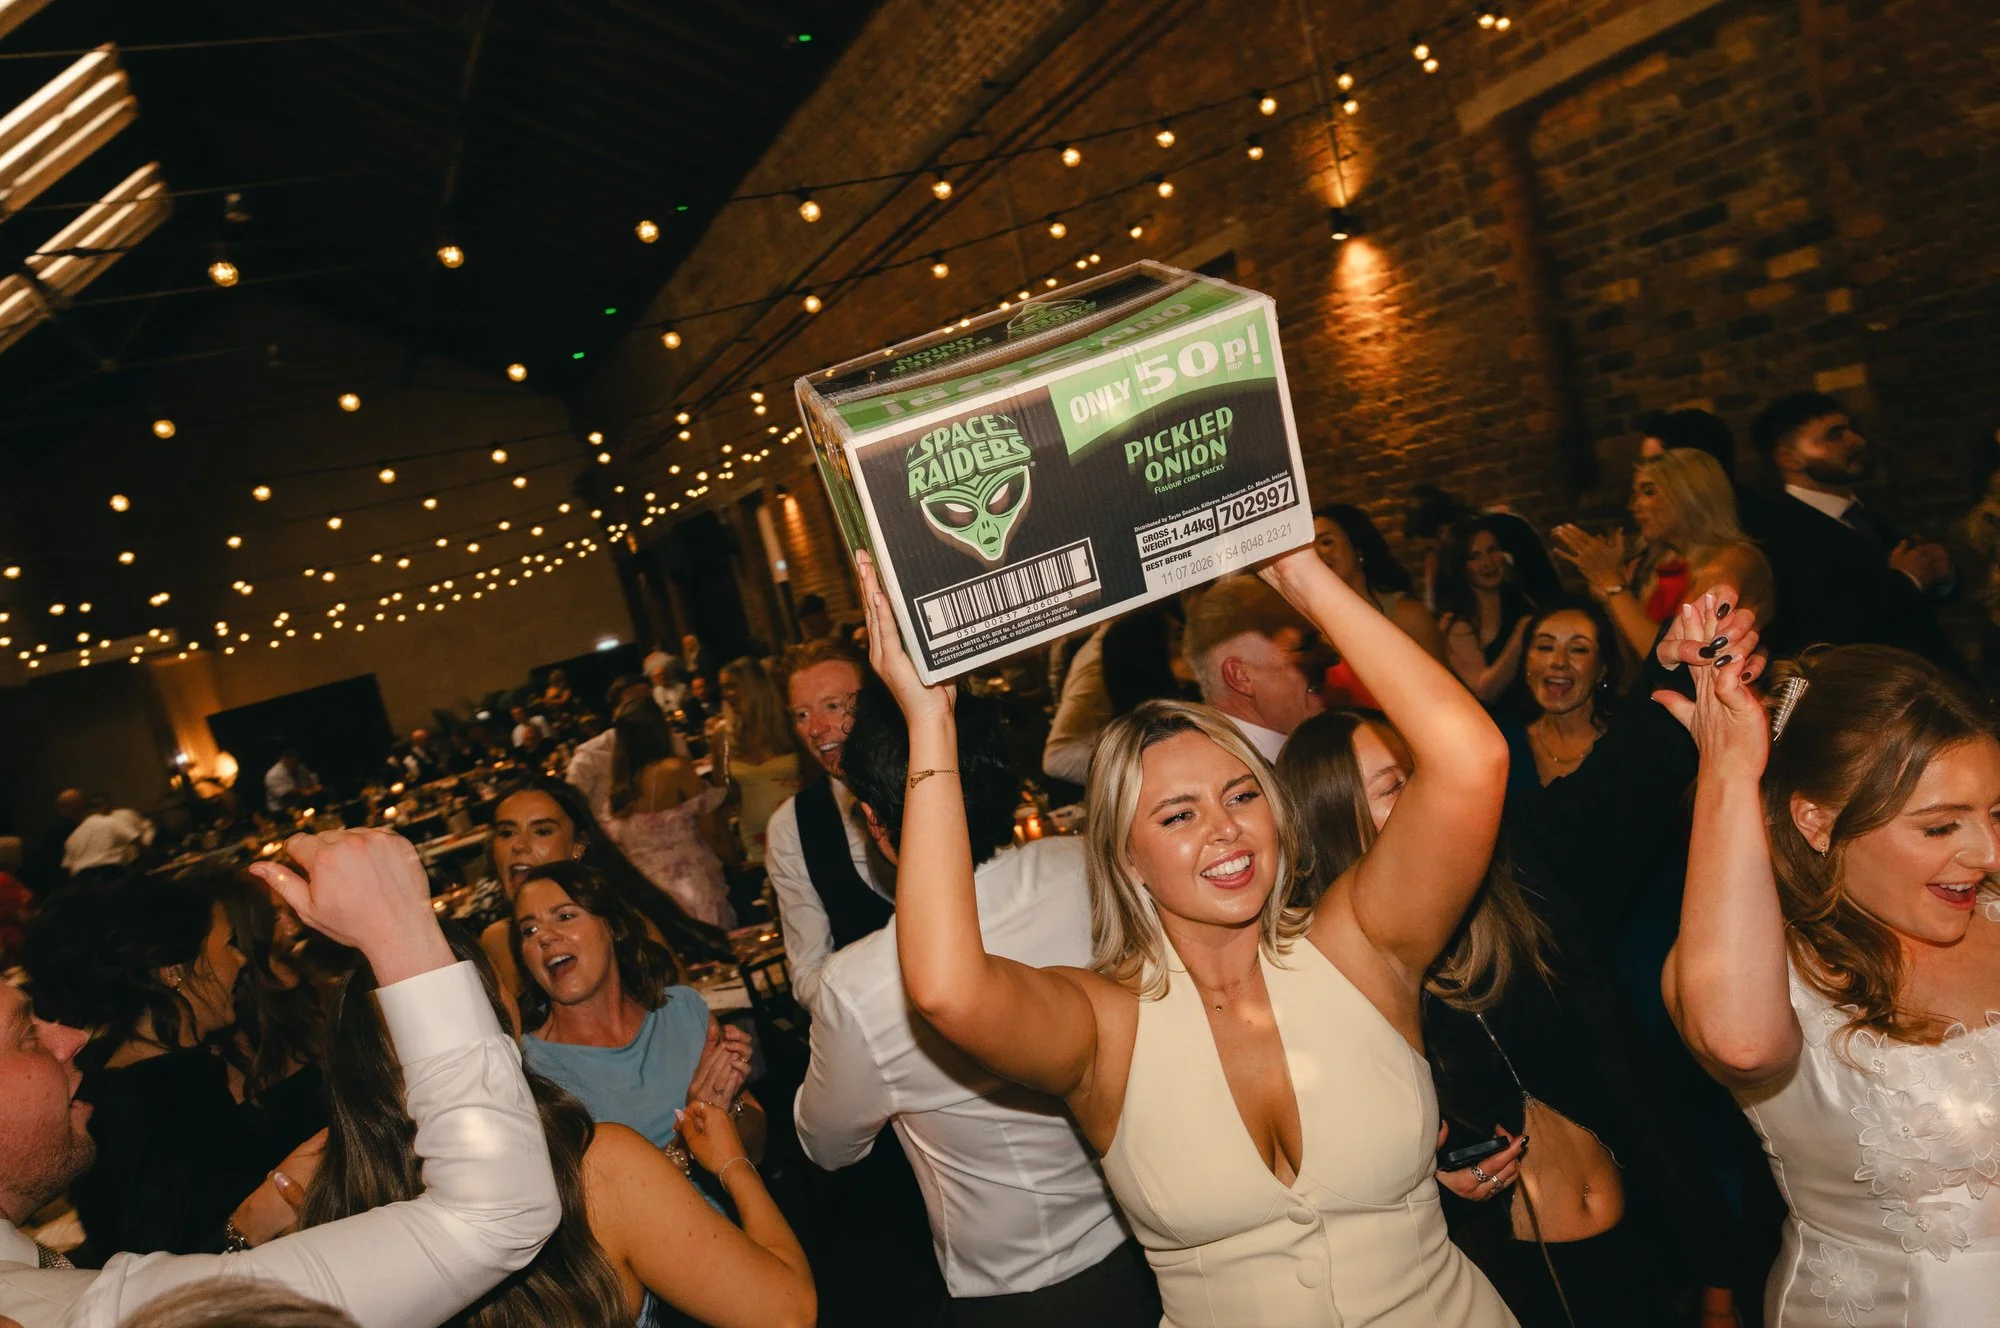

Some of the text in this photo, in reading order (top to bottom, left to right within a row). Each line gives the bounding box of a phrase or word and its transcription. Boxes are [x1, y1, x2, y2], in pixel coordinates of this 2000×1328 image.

[889, 336, 992, 373] PICKLED
[895, 337, 974, 365] ONION
[1069, 323, 1262, 424] ONLY 50p!
[908, 414, 1019, 469] SPACE
[1124, 406, 1234, 464] PICKLED
[908, 436, 1032, 498] RAIDERS
[1144, 435, 1227, 482] ONION
[1183, 473, 1201, 483] CORN
[1201, 464, 1225, 477] SNACKS
[1133, 518, 1161, 532] Distributed
[1161, 516, 1168, 524] by
[1168, 513, 1182, 522] Tayto
[1219, 481, 1290, 526] 702997
[1142, 516, 1214, 554] WEIGHT 1.44kg
[1142, 528, 1170, 544] GROSS
[1162, 571, 1173, 585] 11
[1175, 565, 1187, 580] 07
[1191, 555, 1214, 575] 2026
[1215, 550, 1223, 564] Y
[1241, 536, 1264, 554] 6048
[1267, 522, 1292, 543] 23:21
[1145, 550, 1193, 572] BEST BEFORE
[956, 591, 1074, 639] 050 00237 20600 3
[1015, 620, 1046, 636] REGISTERED
[1046, 614, 1063, 624] TRADE
[1062, 608, 1078, 619] MARK
[939, 645, 961, 657] SNACKS
[991, 629, 1002, 637] BOX
